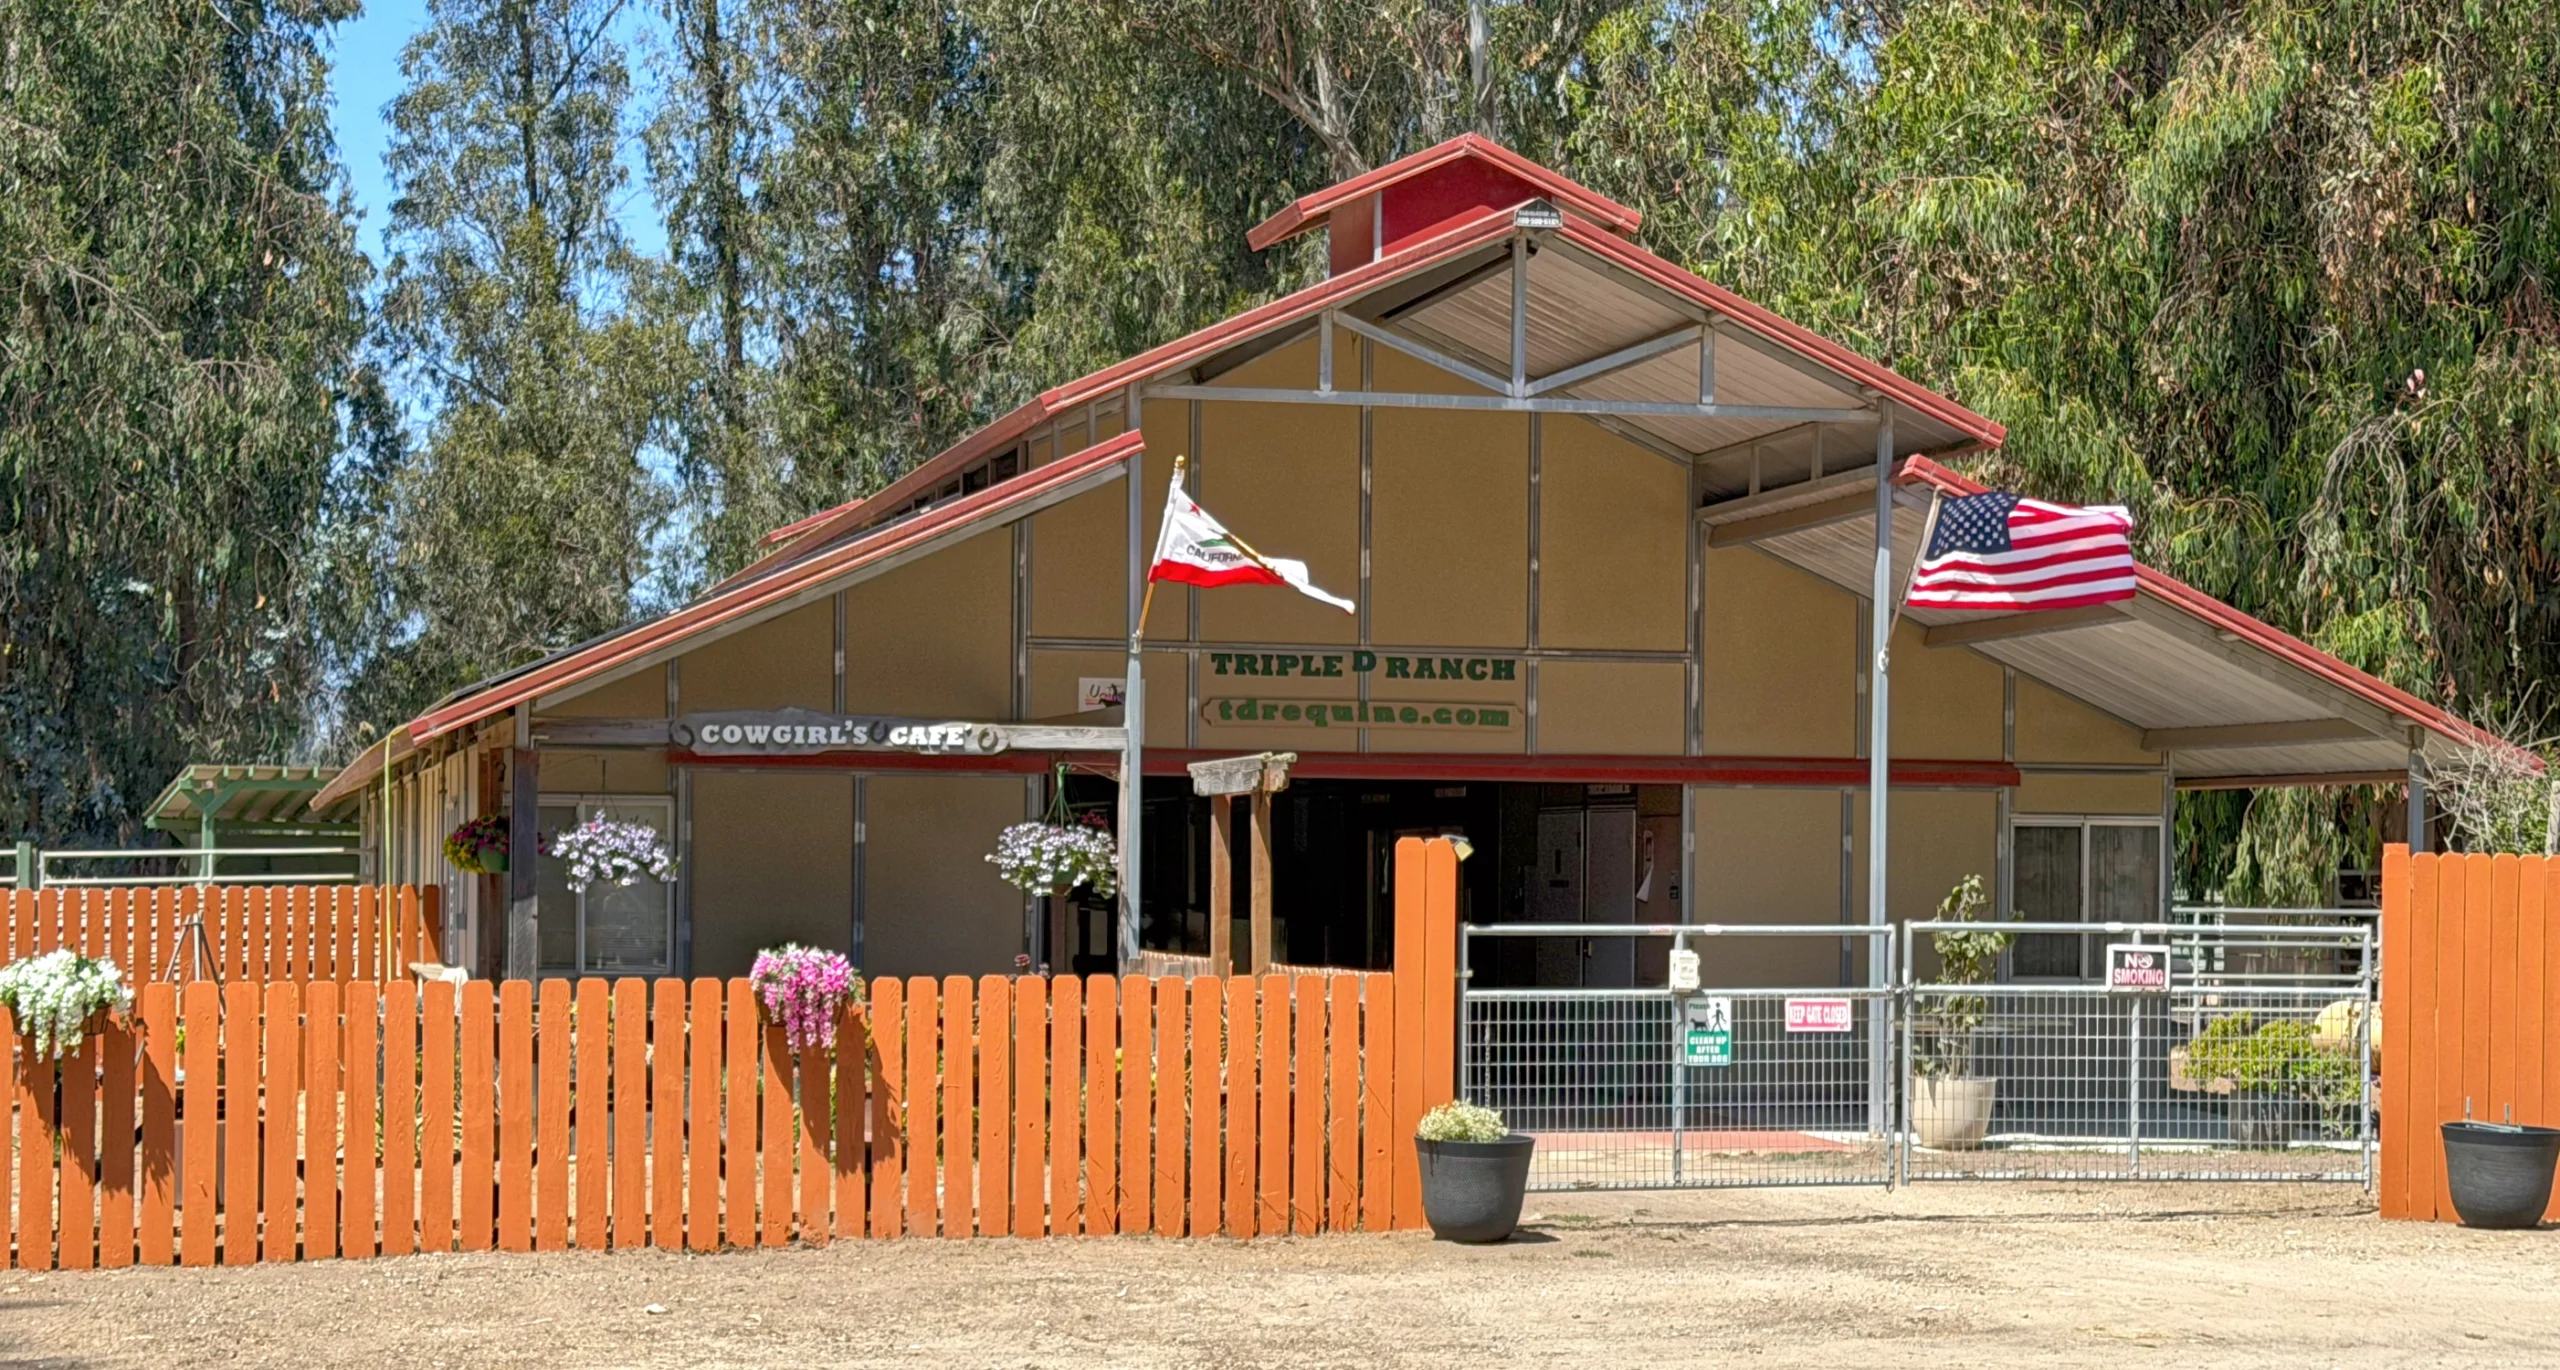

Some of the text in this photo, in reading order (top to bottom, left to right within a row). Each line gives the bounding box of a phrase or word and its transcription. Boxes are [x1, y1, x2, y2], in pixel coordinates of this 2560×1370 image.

[1186, 544, 1245, 563] CALIFORN
[1211, 650, 1516, 681] TRIPLE D RANCH
[1218, 698, 1510, 728] tdrequine.com
[701, 720, 868, 745] COWGIRL'S
[2124, 953, 2154, 969] NO
[2114, 968, 2164, 985] SMOKING
[1789, 1005, 1848, 1024] KEEP GATE CLOSED
[1689, 1036, 1728, 1045] CLEAN UP
[1696, 1045, 1720, 1054] AFTER
[1687, 1054, 1710, 1063] YOUR
